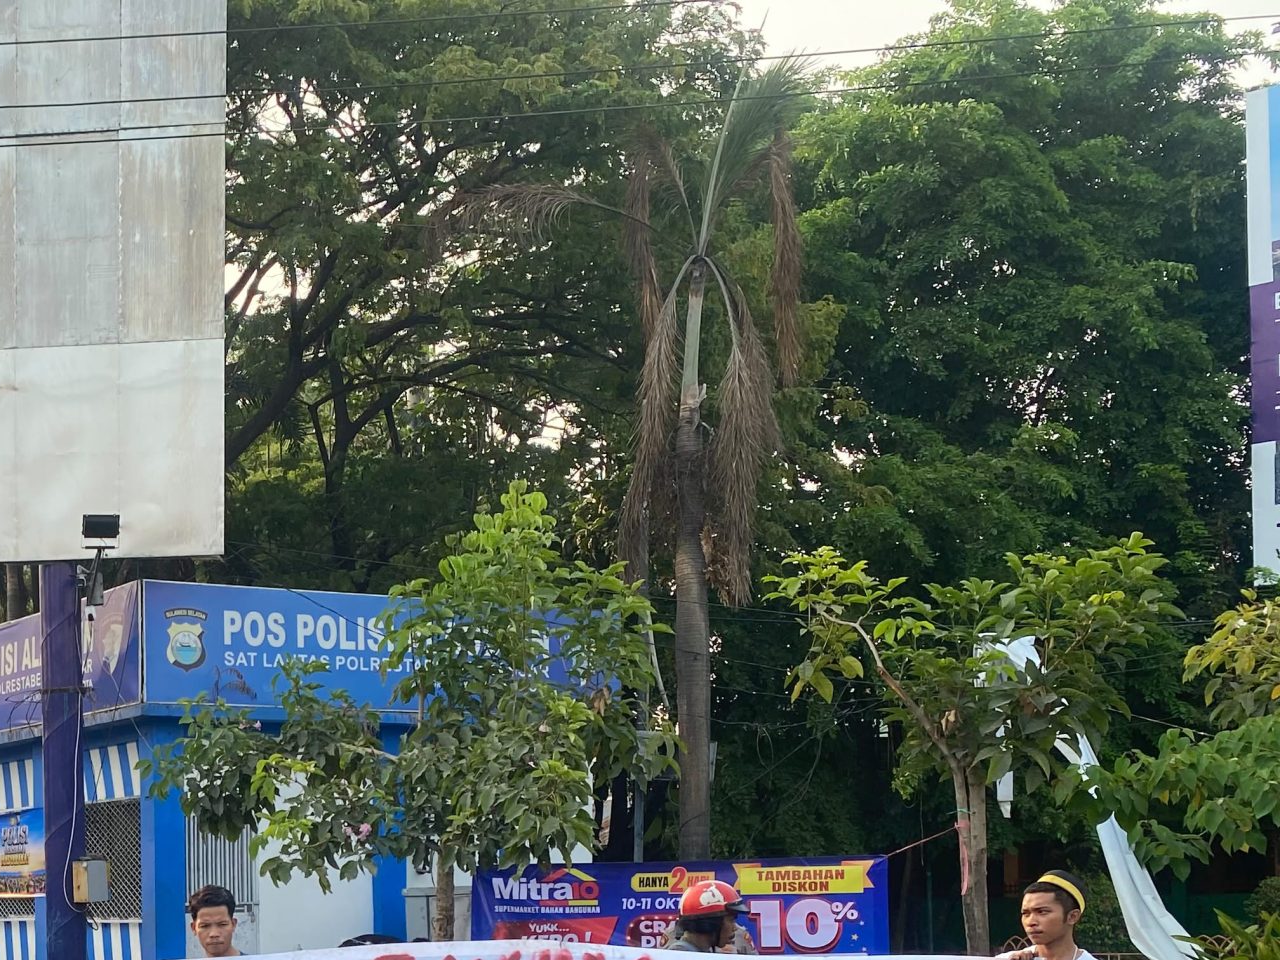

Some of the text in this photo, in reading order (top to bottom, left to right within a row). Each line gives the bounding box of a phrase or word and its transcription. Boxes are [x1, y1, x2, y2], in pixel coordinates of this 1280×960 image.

[224, 610, 286, 648] POS
[224, 651, 257, 667] SAT
[638, 876, 669, 888] HANYA
[669, 866, 688, 894] 2
[756, 869, 845, 882] TAMBAHAN
[772, 881, 830, 893] DISKON
[494, 905, 601, 914] SUPERMARKET BAHAN BANGUNAN
[622, 897, 652, 910] 10-11
